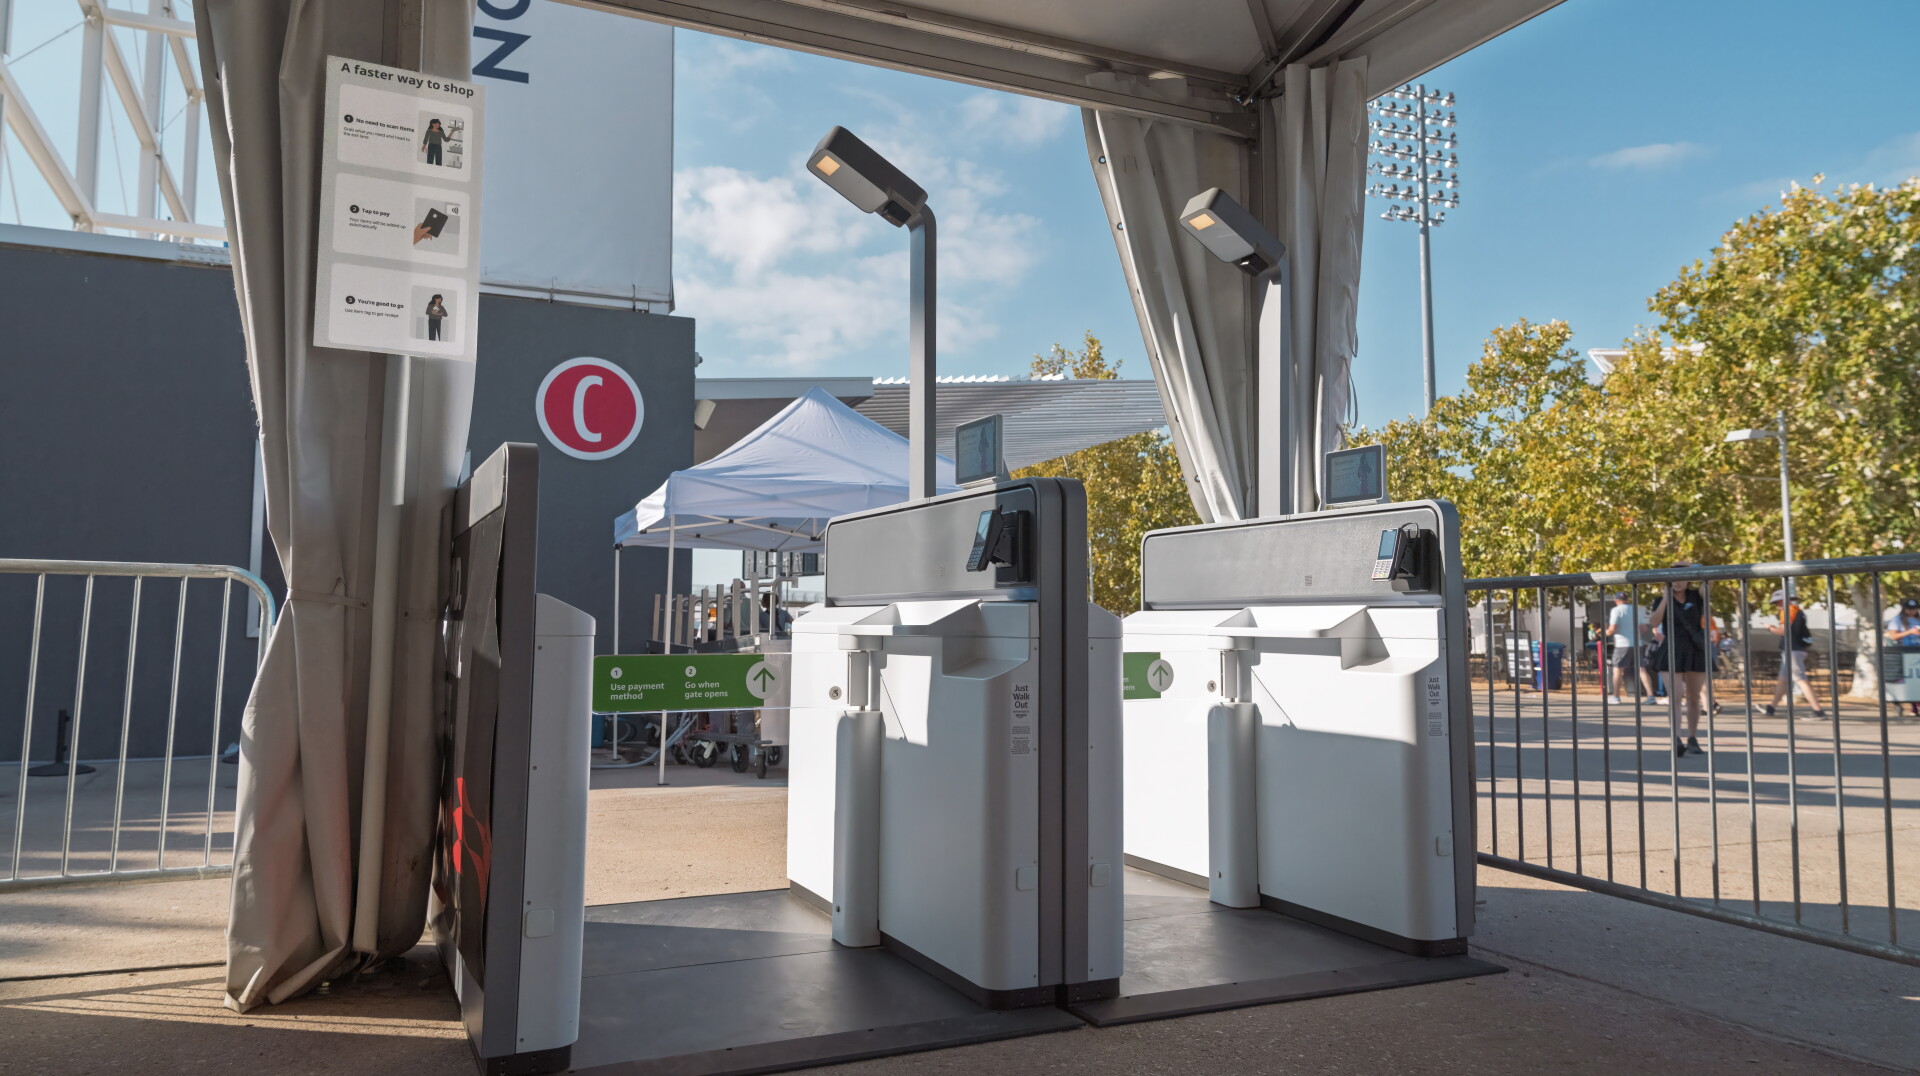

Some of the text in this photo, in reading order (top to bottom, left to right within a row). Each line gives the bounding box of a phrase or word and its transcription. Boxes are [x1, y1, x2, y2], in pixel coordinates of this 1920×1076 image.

[341, 62, 474, 98] A faster way to shop
[573, 375, 603, 443] C
[610, 682, 664, 692] Use payment
[685, 681, 720, 689] Go when
[1014, 684, 1028, 692] Just
[610, 692, 643, 700] method
[685, 690, 728, 699] gate opens
